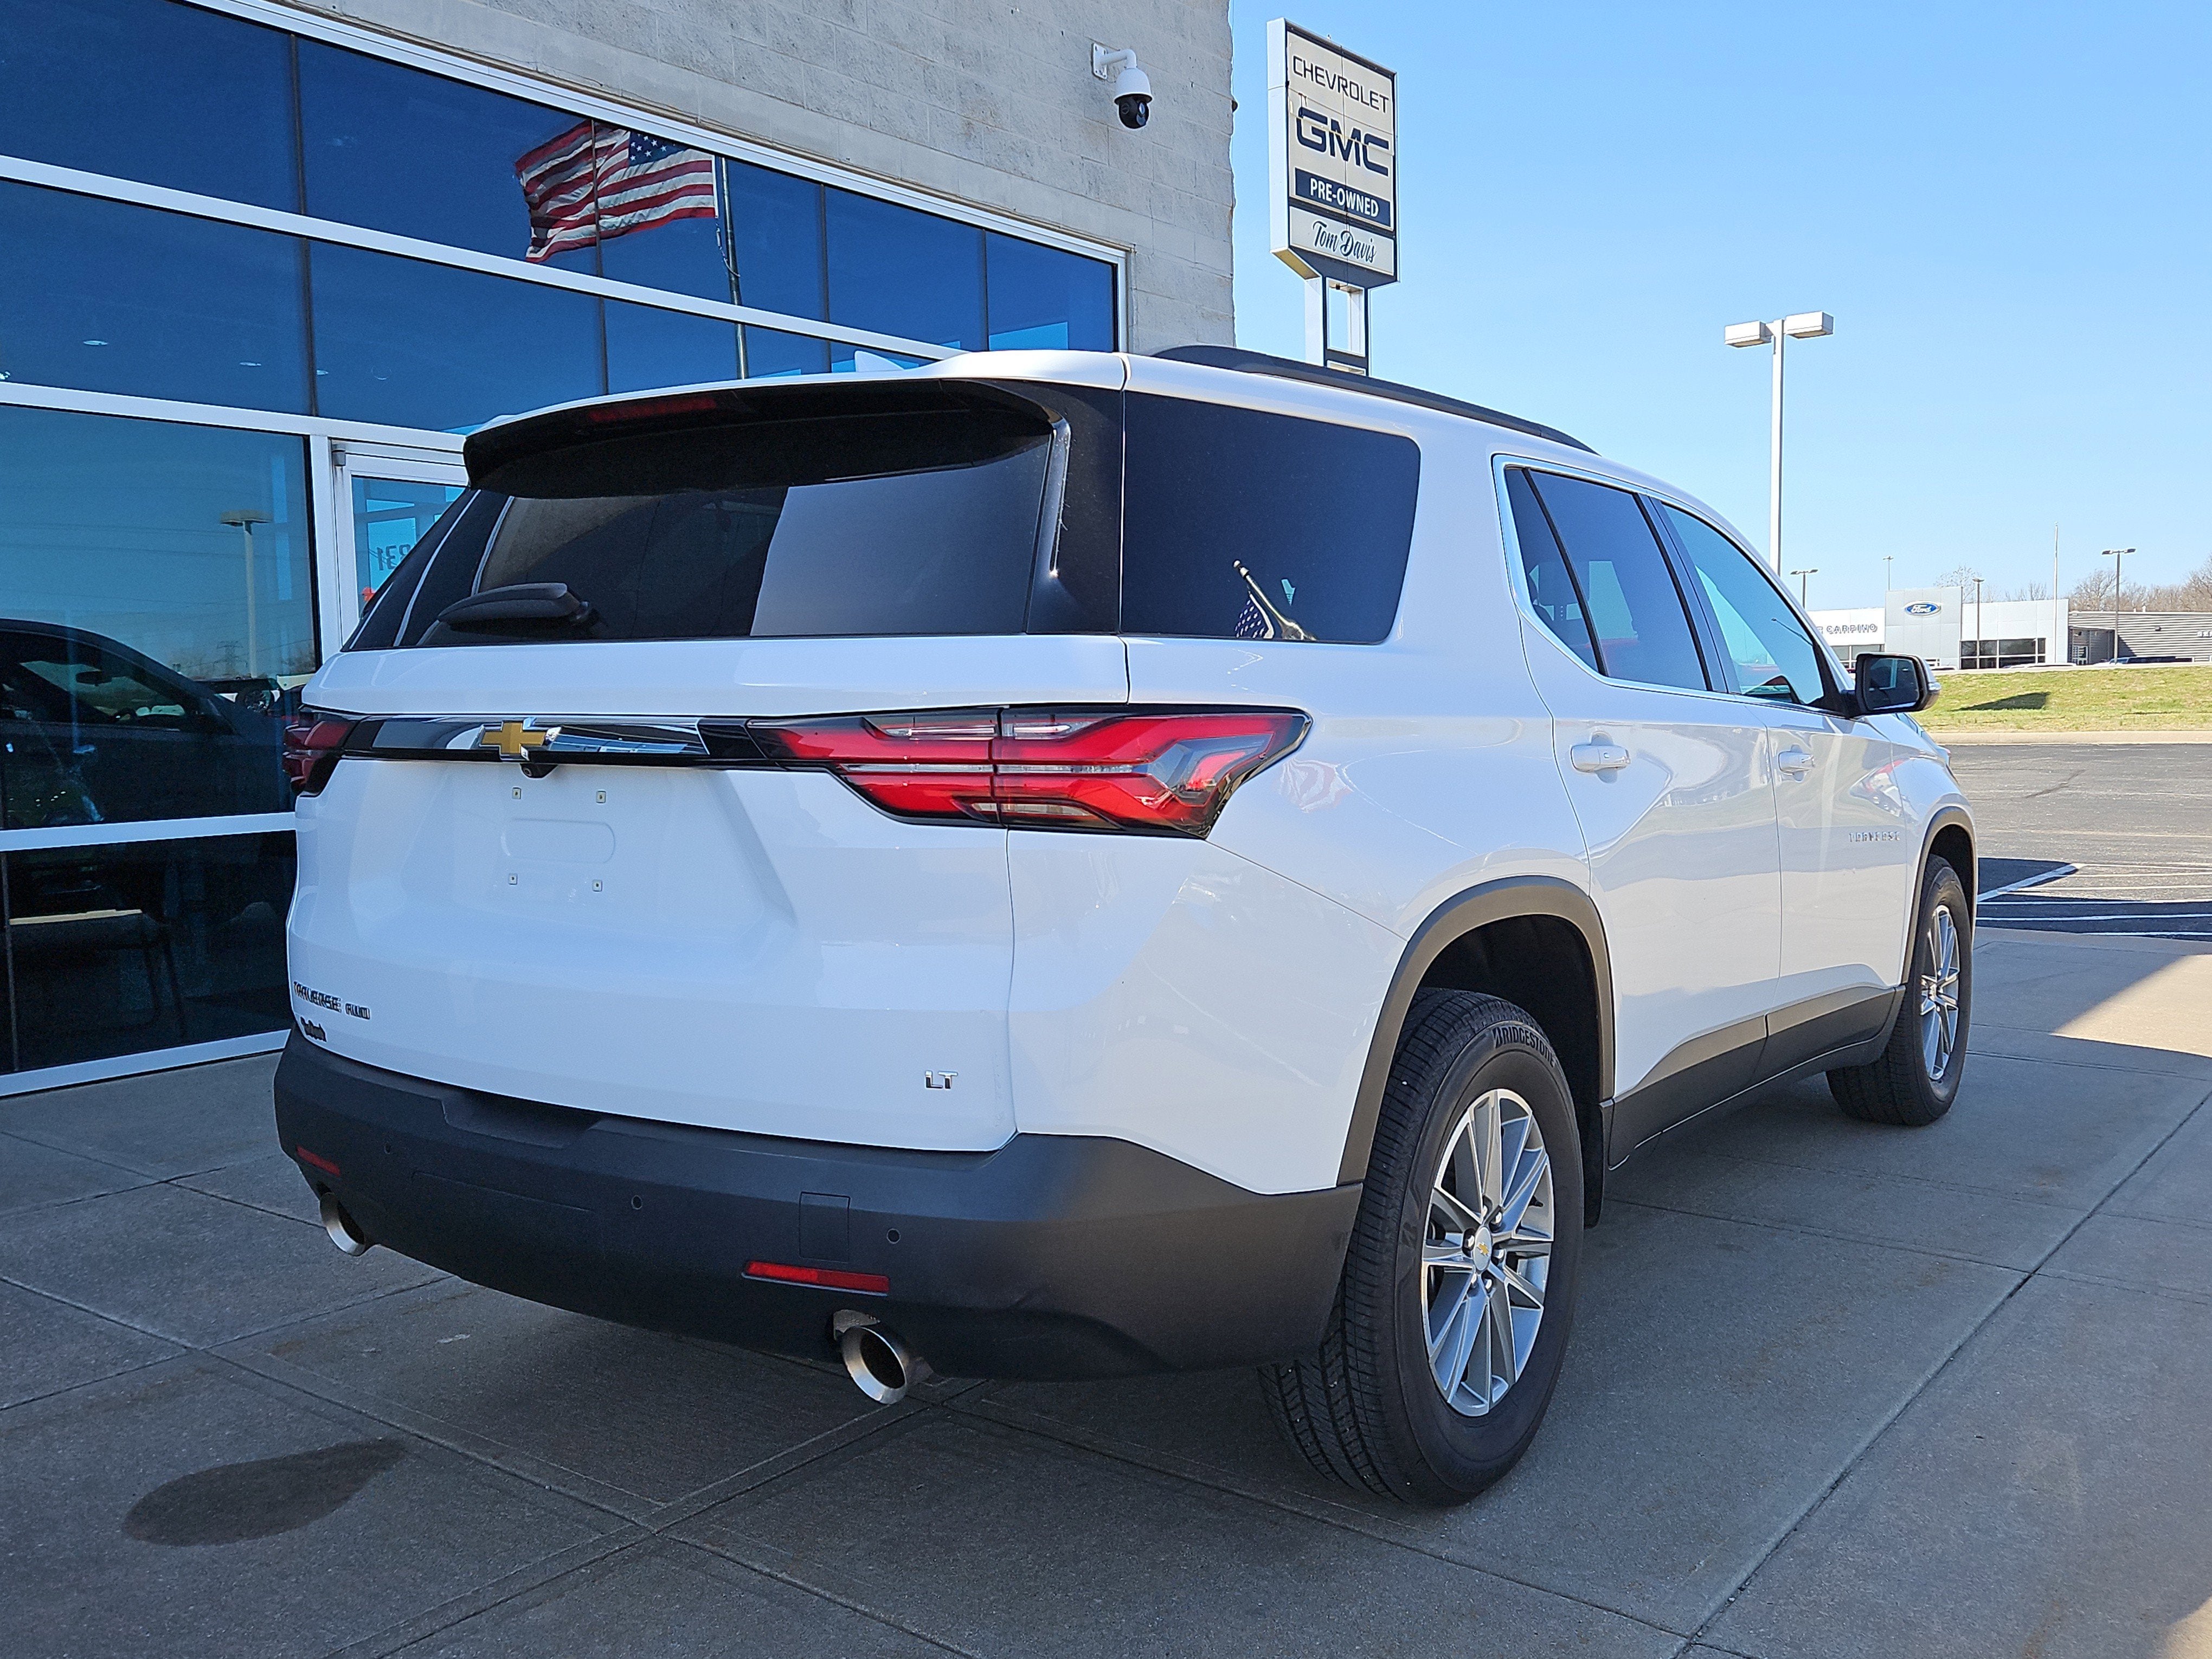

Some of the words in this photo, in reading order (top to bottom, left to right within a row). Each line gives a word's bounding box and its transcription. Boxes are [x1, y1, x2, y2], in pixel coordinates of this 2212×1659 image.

[1293, 55, 1389, 113] CHEVROLET
[1296, 107, 1389, 177] GMC
[1310, 178, 1379, 217] PRE-OWNED
[1313, 221, 1339, 252] Tom
[1340, 230, 1376, 262] Davis
[1827, 624, 1877, 634] CARPINO
[1493, 1026, 1554, 1068] BRIDGESTONE
[925, 1070, 958, 1089] LT
